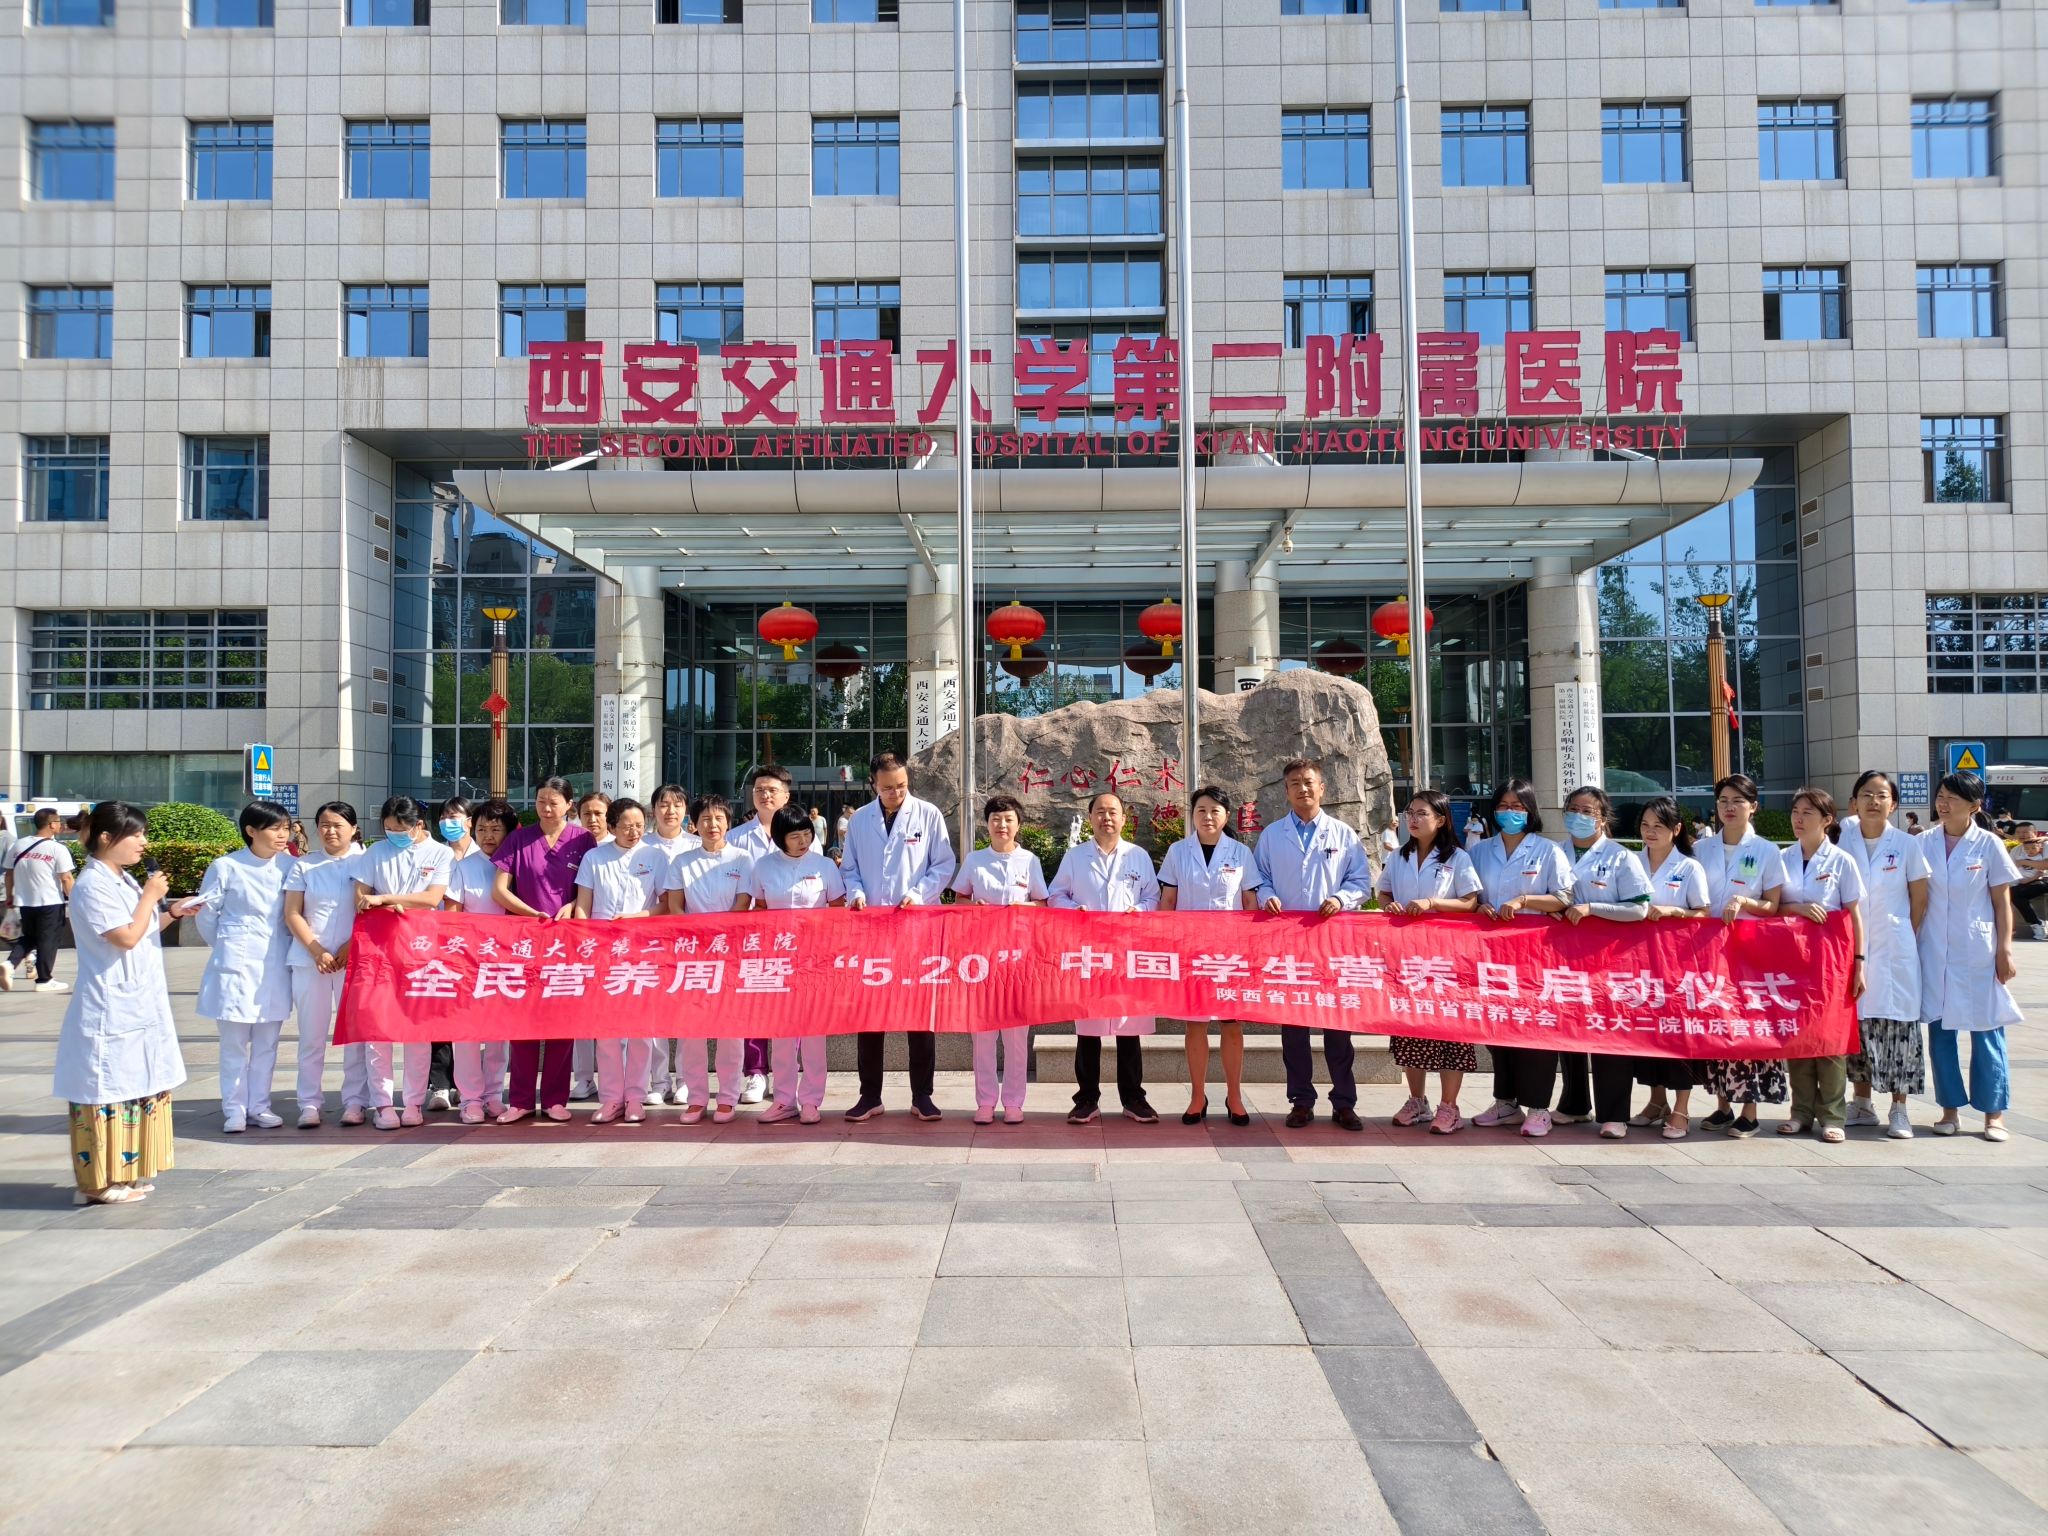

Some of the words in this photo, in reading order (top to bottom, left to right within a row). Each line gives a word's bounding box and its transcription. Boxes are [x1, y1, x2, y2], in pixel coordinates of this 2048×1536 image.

[528, 328, 1684, 425] 西安交通大学第二附属医院
[522, 433, 583, 458] THE
[601, 433, 734, 458] SECOND
[751, 432, 933, 458] AFFILIATED
[953, 431, 1112, 457] OSPITAL
[1127, 431, 1171, 455] OF
[1480, 424, 1687, 450] UNIVERSITY
[915, 680, 929, 749] 西安交通大学
[1018, 757, 1185, 794] 仁心仁术
[408, 932, 799, 960] 西安交通大学第二附属医院
[404, 957, 798, 999] 全民营养周暨
[1060, 945, 1802, 1012] 中国学生营养日启动仪式
[1216, 986, 1362, 1011] 陕西省卫健委
[1389, 996, 1559, 1028] 陕西省营养学会
[1585, 1014, 1801, 1037] 交大二院临床营养科
